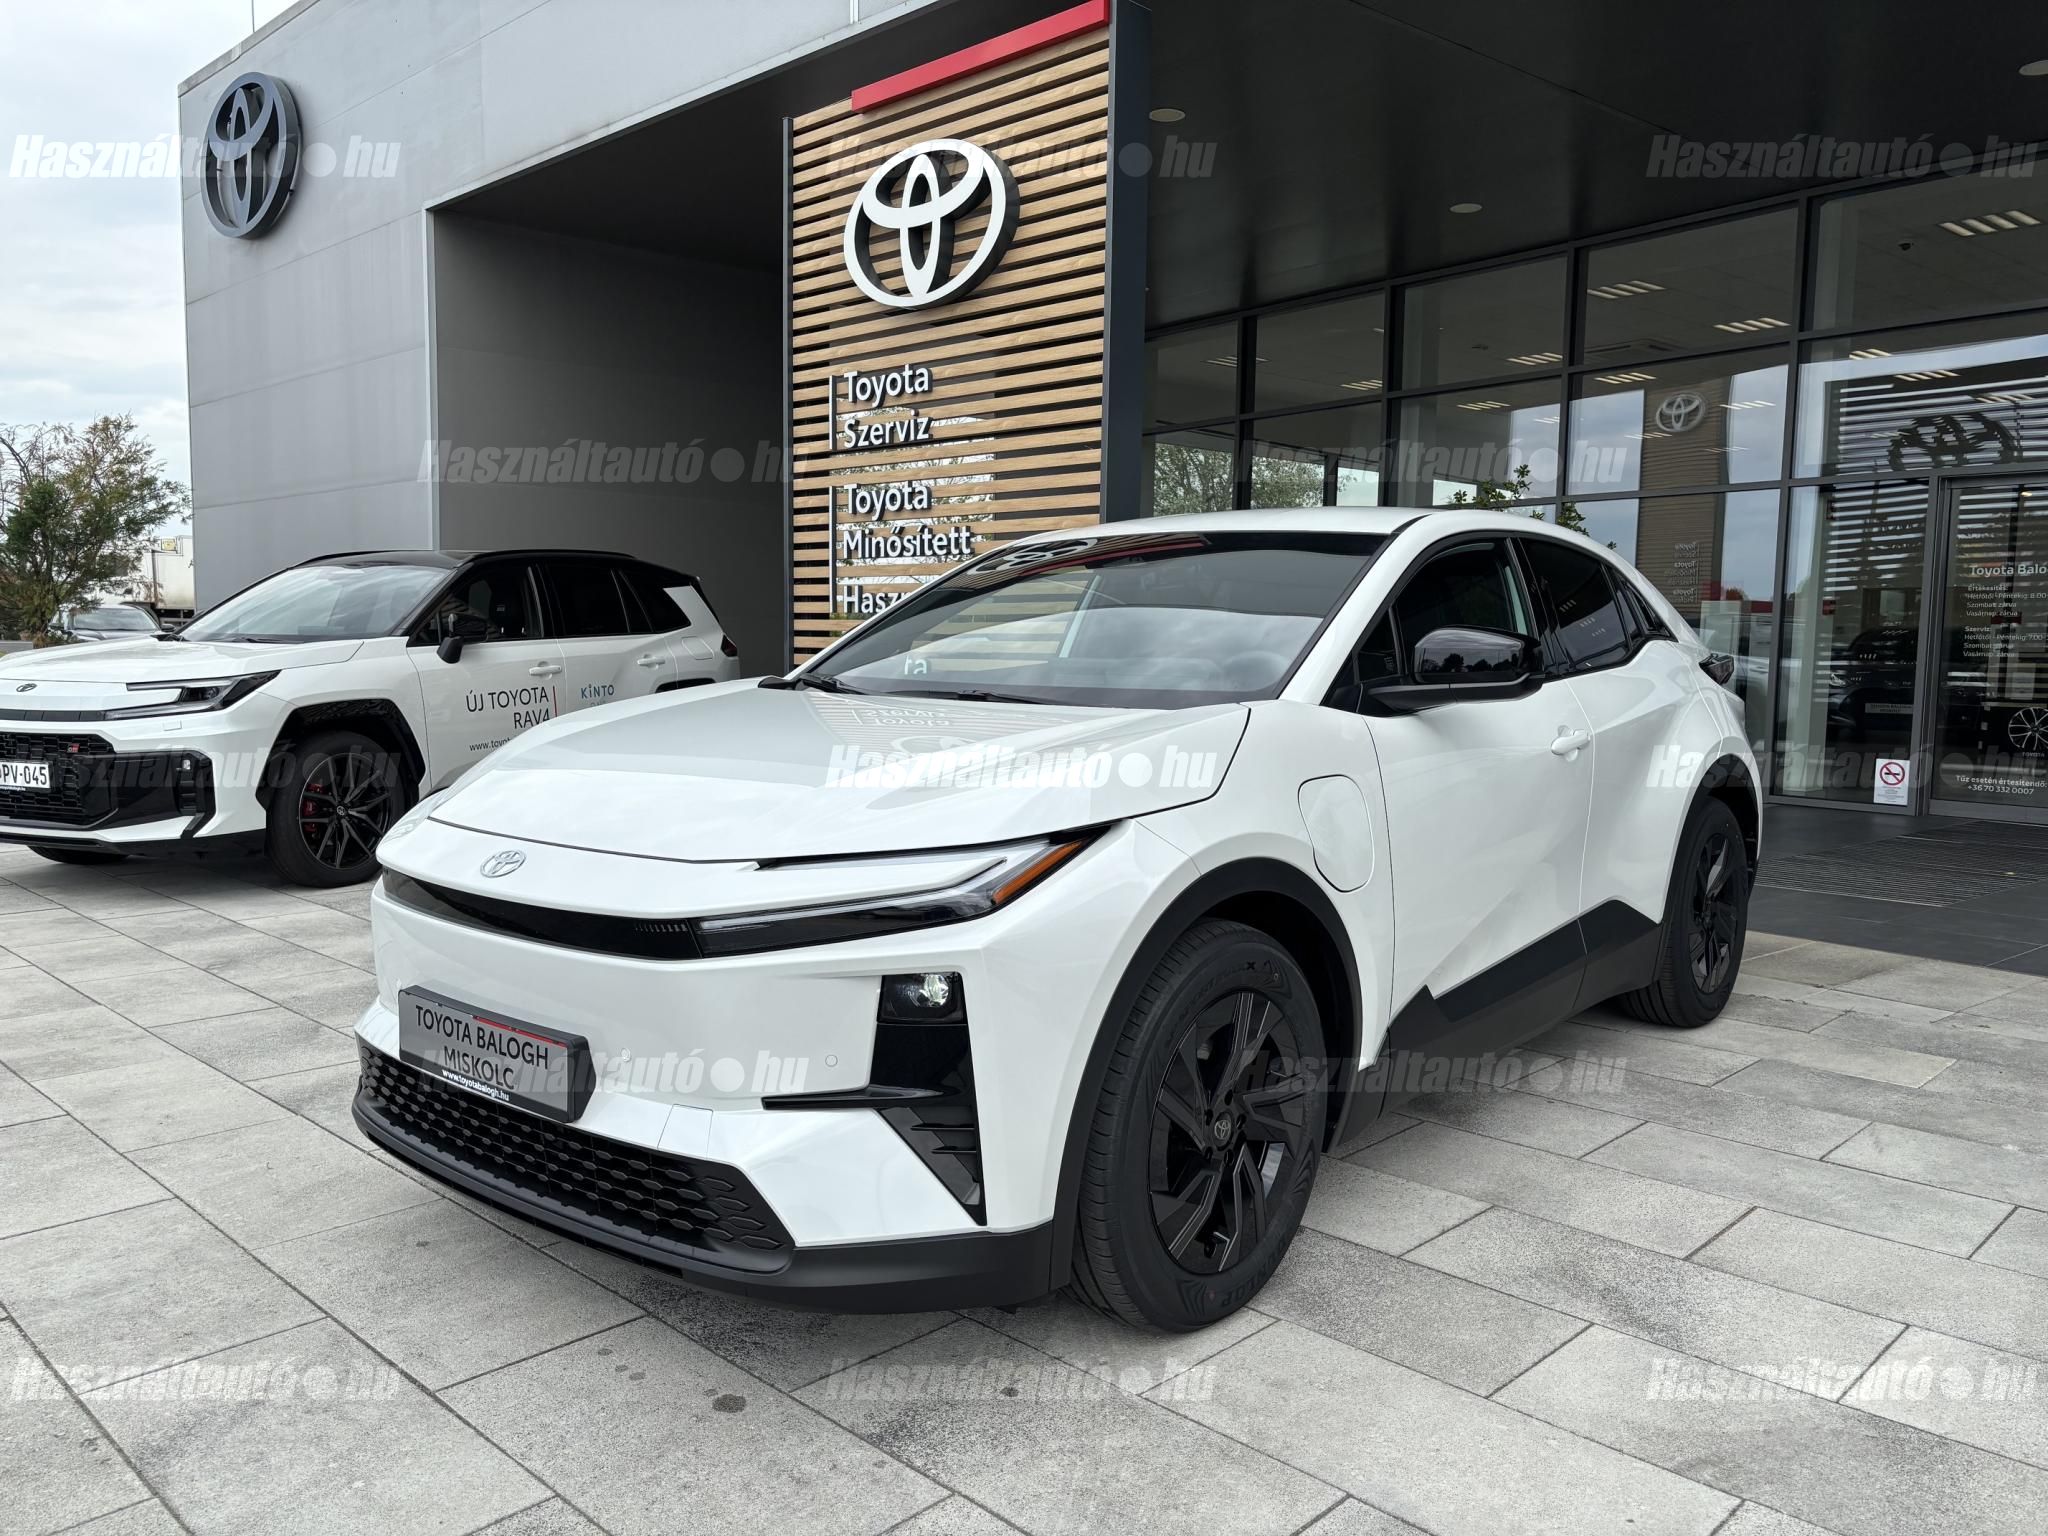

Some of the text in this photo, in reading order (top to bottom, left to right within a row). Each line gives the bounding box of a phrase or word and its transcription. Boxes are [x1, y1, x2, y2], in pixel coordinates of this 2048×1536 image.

[843, 363, 930, 408] Toyota
[843, 408, 931, 449] Szerviz
[843, 482, 930, 521] Toyota
[843, 525, 971, 560] Minősített
[1971, 565, 2014, 578] Toyota
[466, 686, 549, 713] ÚJ TOYOTA
[513, 708, 550, 729] RAV4
[0, 764, 47, 785] PV-045
[1970, 776, 1998, 785] esetén
[1996, 786, 2010, 794] 332
[415, 1004, 549, 1069] TOYOTA BALOGH
[443, 1045, 515, 1090] MISKOLC
[442, 1068, 510, 1101] www.toyotabalogh.hu
